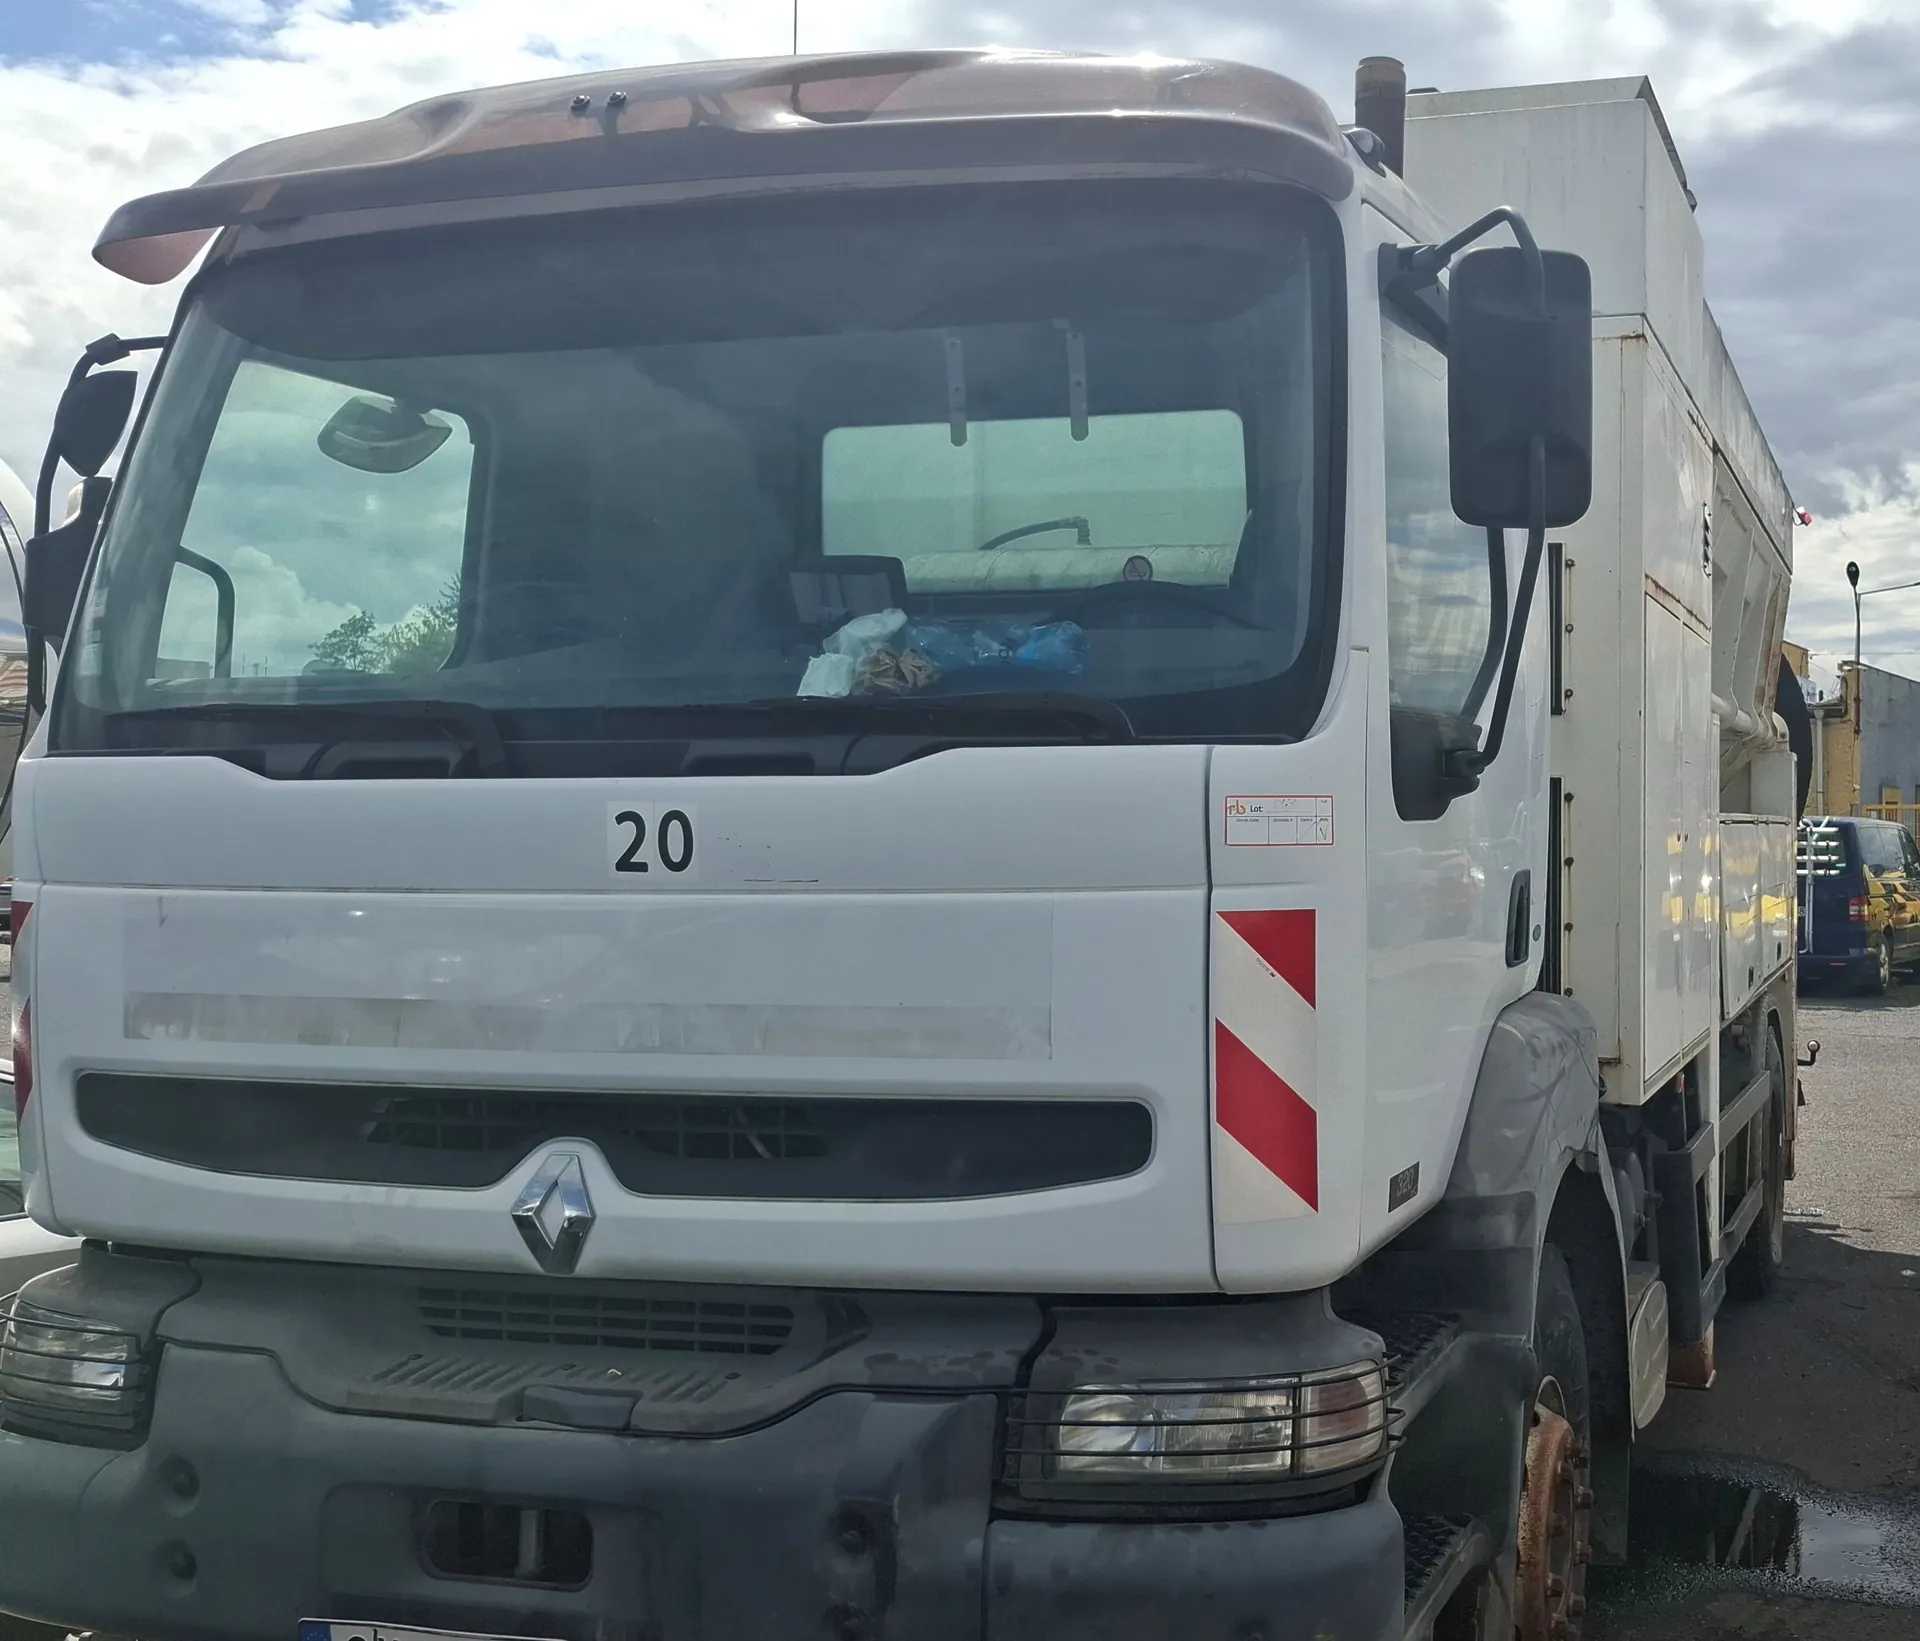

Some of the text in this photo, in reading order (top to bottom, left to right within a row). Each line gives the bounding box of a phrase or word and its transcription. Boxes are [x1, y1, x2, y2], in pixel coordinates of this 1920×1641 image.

[1227, 799, 1246, 815] rb
[1249, 805, 1264, 813] Lot:
[614, 809, 694, 873] 20
[1396, 1167, 1414, 1197] 320
